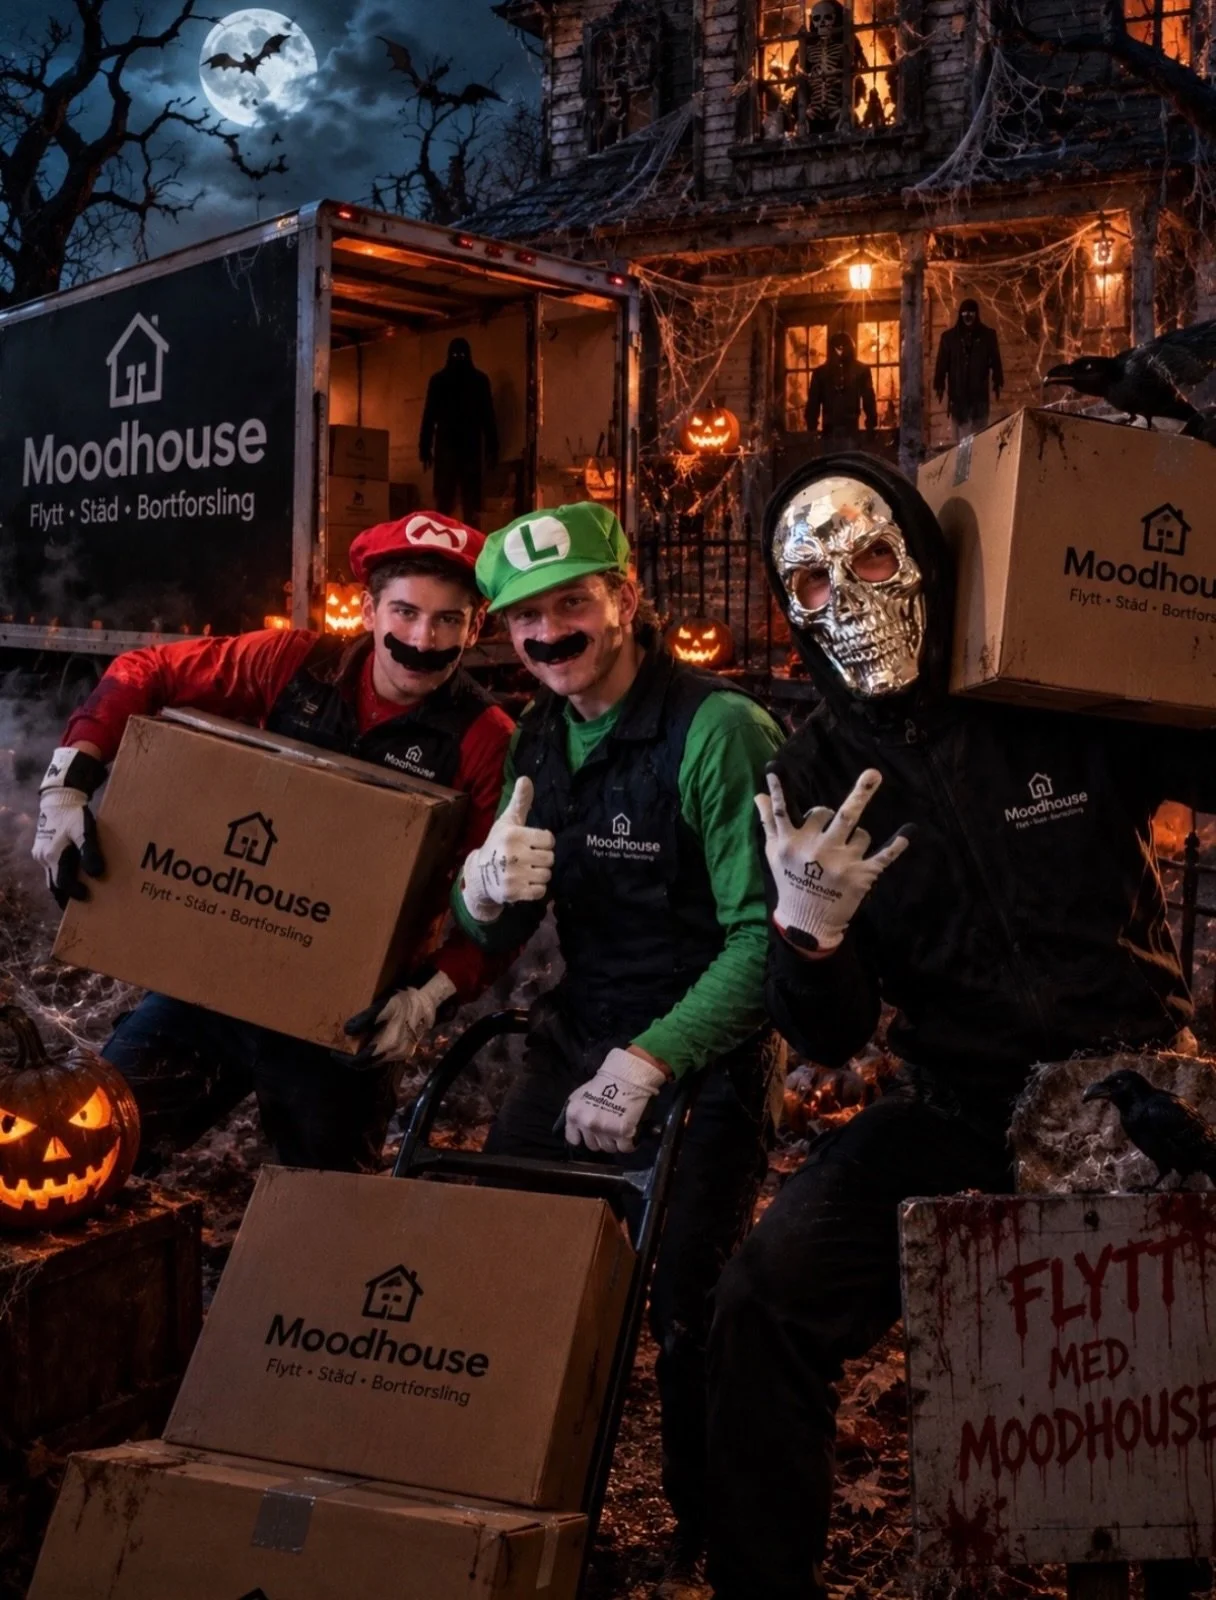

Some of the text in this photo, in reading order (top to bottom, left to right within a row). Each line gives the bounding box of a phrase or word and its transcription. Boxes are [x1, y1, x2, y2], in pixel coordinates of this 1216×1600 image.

[22, 417, 267, 487] Moodhouse
[30, 488, 255, 532] Flytt Städ Bortforsling
[519, 525, 559, 562] L
[1069, 588, 1101, 607] Flytt
[1004, 791, 1088, 822] Moodhouse
[586, 834, 660, 853] Moodhouse
[140, 841, 331, 924] Moodhouse
[140, 881, 172, 901] Flytt
[230, 908, 313, 947] Bortforsling
[265, 1313, 489, 1378] Moodhouse
[1048, 1337, 1129, 1390] MED
[265, 1357, 471, 1408] Flytt Städ Bortforsling
[959, 1380, 1216, 1481] MOODHOUSE
